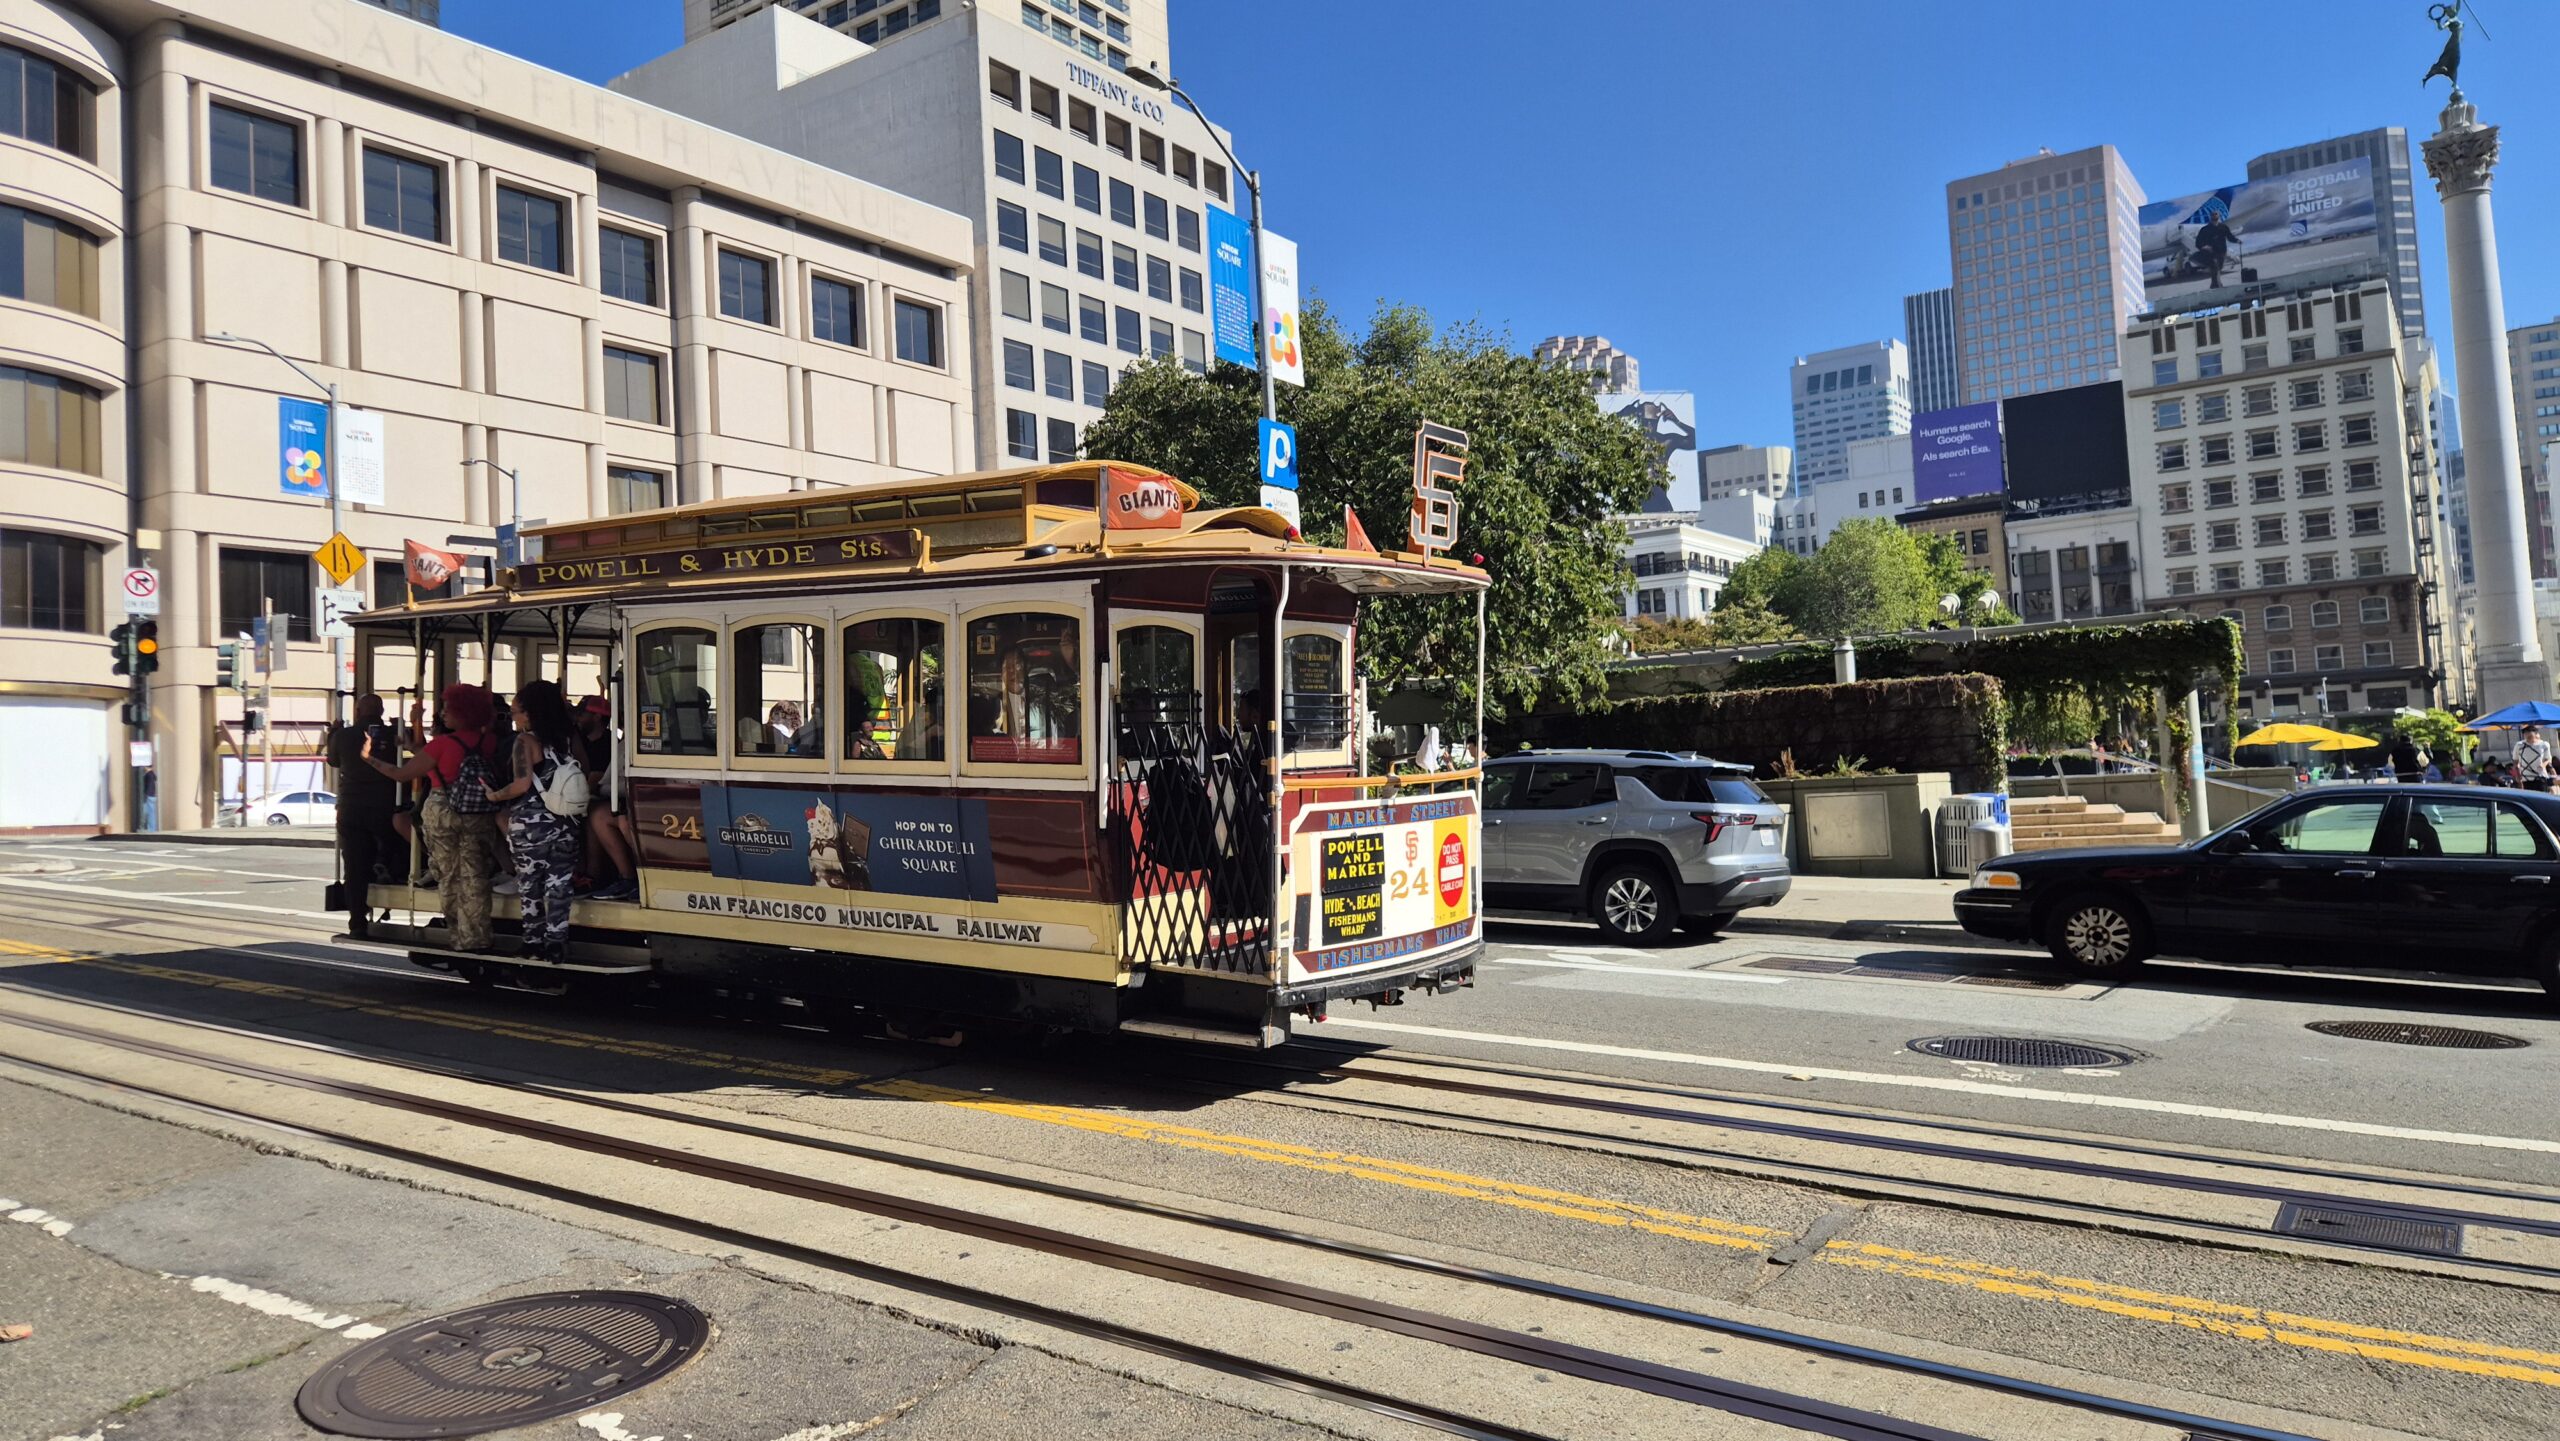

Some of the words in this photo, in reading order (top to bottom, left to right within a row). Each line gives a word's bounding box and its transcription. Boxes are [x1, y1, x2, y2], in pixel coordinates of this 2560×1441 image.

[1066, 61, 1128, 106] TIFFANY
[311, 4, 487, 99] SAKS
[530, 73, 689, 166] FIFTH
[727, 150, 912, 241] AVENUE
[2287, 168, 2361, 193] FOOTBALL
[2288, 187, 2325, 204] FLIES
[2289, 196, 2343, 216] UNITED
[1216, 247, 1242, 268] SQUARE
[1265, 270, 1289, 287] SQUARE
[1920, 425, 1958, 438] Humans
[1959, 419, 1991, 432] search
[1937, 432, 1973, 445] Google.
[1938, 447, 1970, 459] search
[1971, 445, 1991, 455] Exa.
[1119, 489, 1179, 513] GIANTS
[538, 559, 660, 583] POWELL
[680, 554, 702, 572] &
[723, 545, 816, 569] HYDE
[840, 538, 890, 559] Sts.
[1327, 807, 1396, 830] MARKET
[1410, 802, 1456, 822] STREET
[661, 814, 701, 840] 24
[895, 821, 916, 831] HOP
[919, 822, 935, 832] ON
[938, 823, 953, 833] TO
[721, 830, 790, 846] GHIRARDELLI
[879, 836, 976, 855] GHIRARDELLI
[1328, 838, 1384, 856] POWELL
[1443, 844, 1451, 855] DO
[1451, 842, 1461, 854] NOT
[901, 857, 958, 873] SQUARE
[1343, 852, 1371, 865] AND
[1445, 853, 1459, 866] PASS
[1327, 861, 1385, 880] MARKET
[1390, 867, 1429, 900] 24
[1324, 897, 1345, 914] HYDE
[1356, 893, 1380, 910] BEACH
[687, 893, 722, 911] SAN
[727, 897, 827, 923] FRANCISCO
[839, 908, 939, 932] MUNICIPAL
[957, 918, 1043, 943] RAILWAY
[1329, 911, 1376, 927] FISHERMANS
[1341, 924, 1365, 936] WHARF
[1317, 935, 1424, 970] FISHERMANS
[1436, 922, 1468, 945] WHARF
